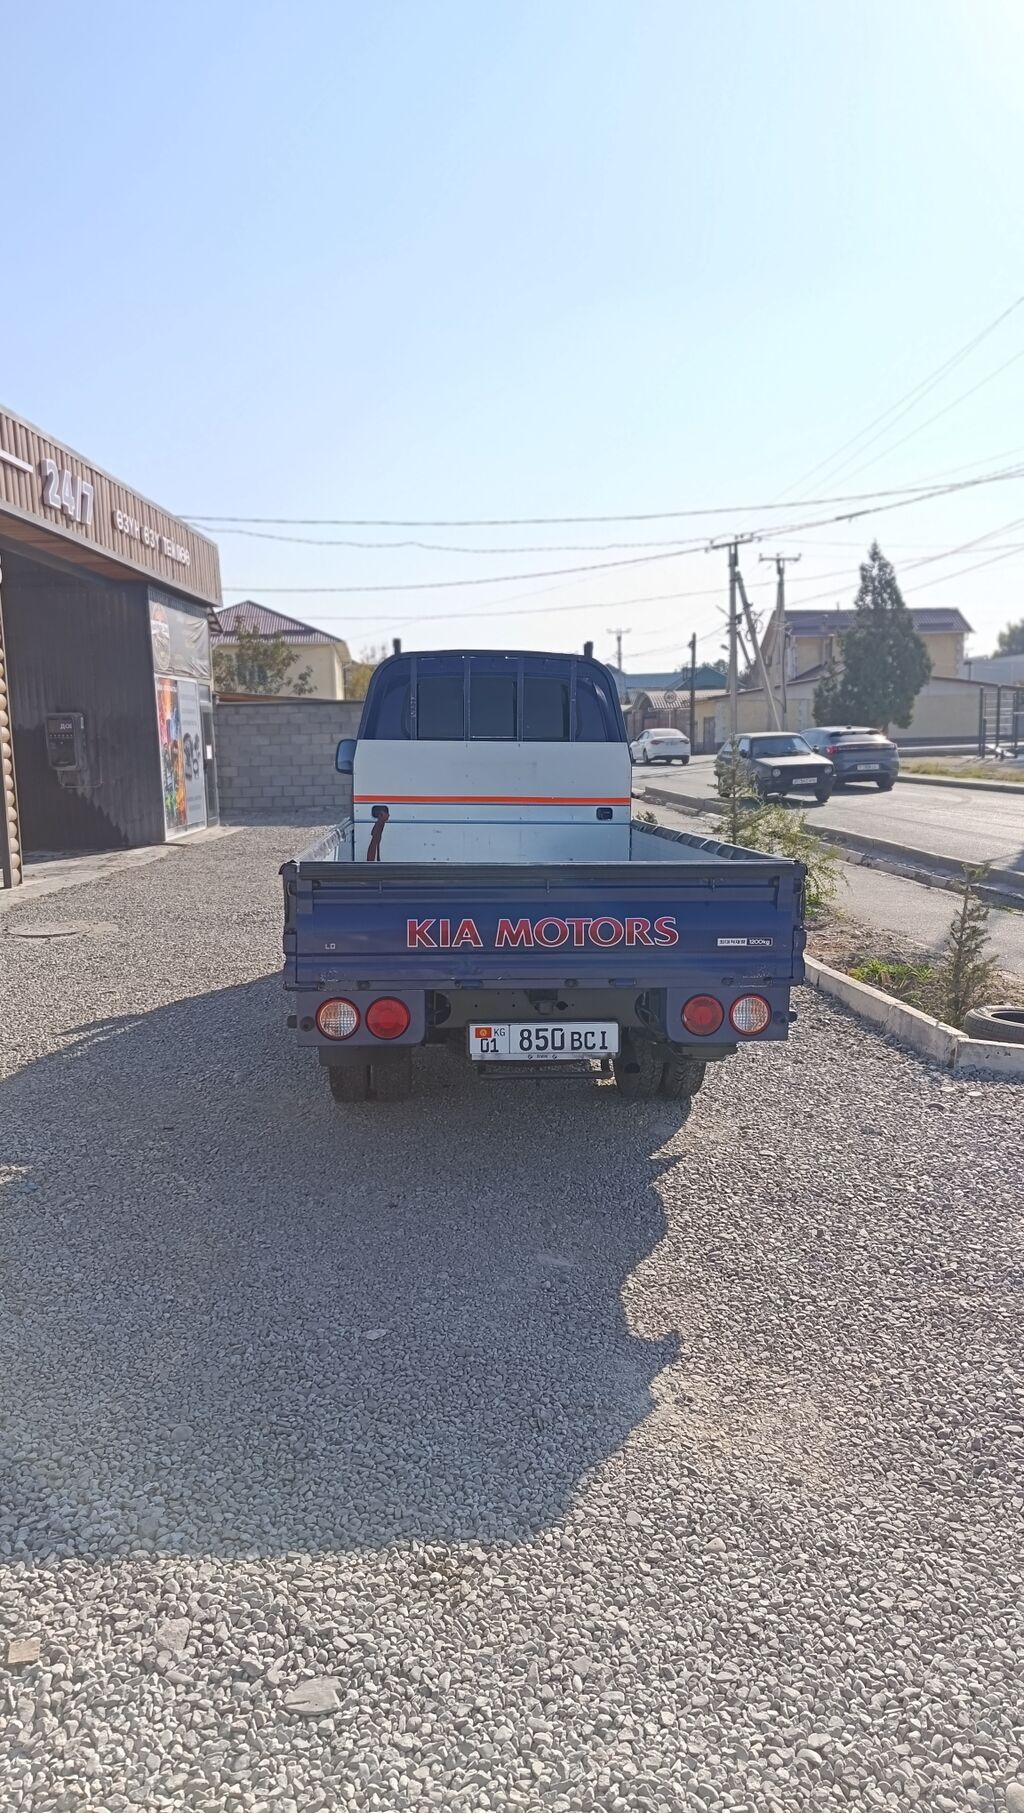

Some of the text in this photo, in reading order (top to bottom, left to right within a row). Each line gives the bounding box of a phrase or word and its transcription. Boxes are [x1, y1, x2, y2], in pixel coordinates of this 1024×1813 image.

[41, 458, 93, 525] 24/7
[407, 916, 679, 948] KIA MOTORS
[494, 1028, 506, 1037] KG
[519, 1028, 608, 1051] 850 BCI
[480, 1038, 499, 1053] 01
